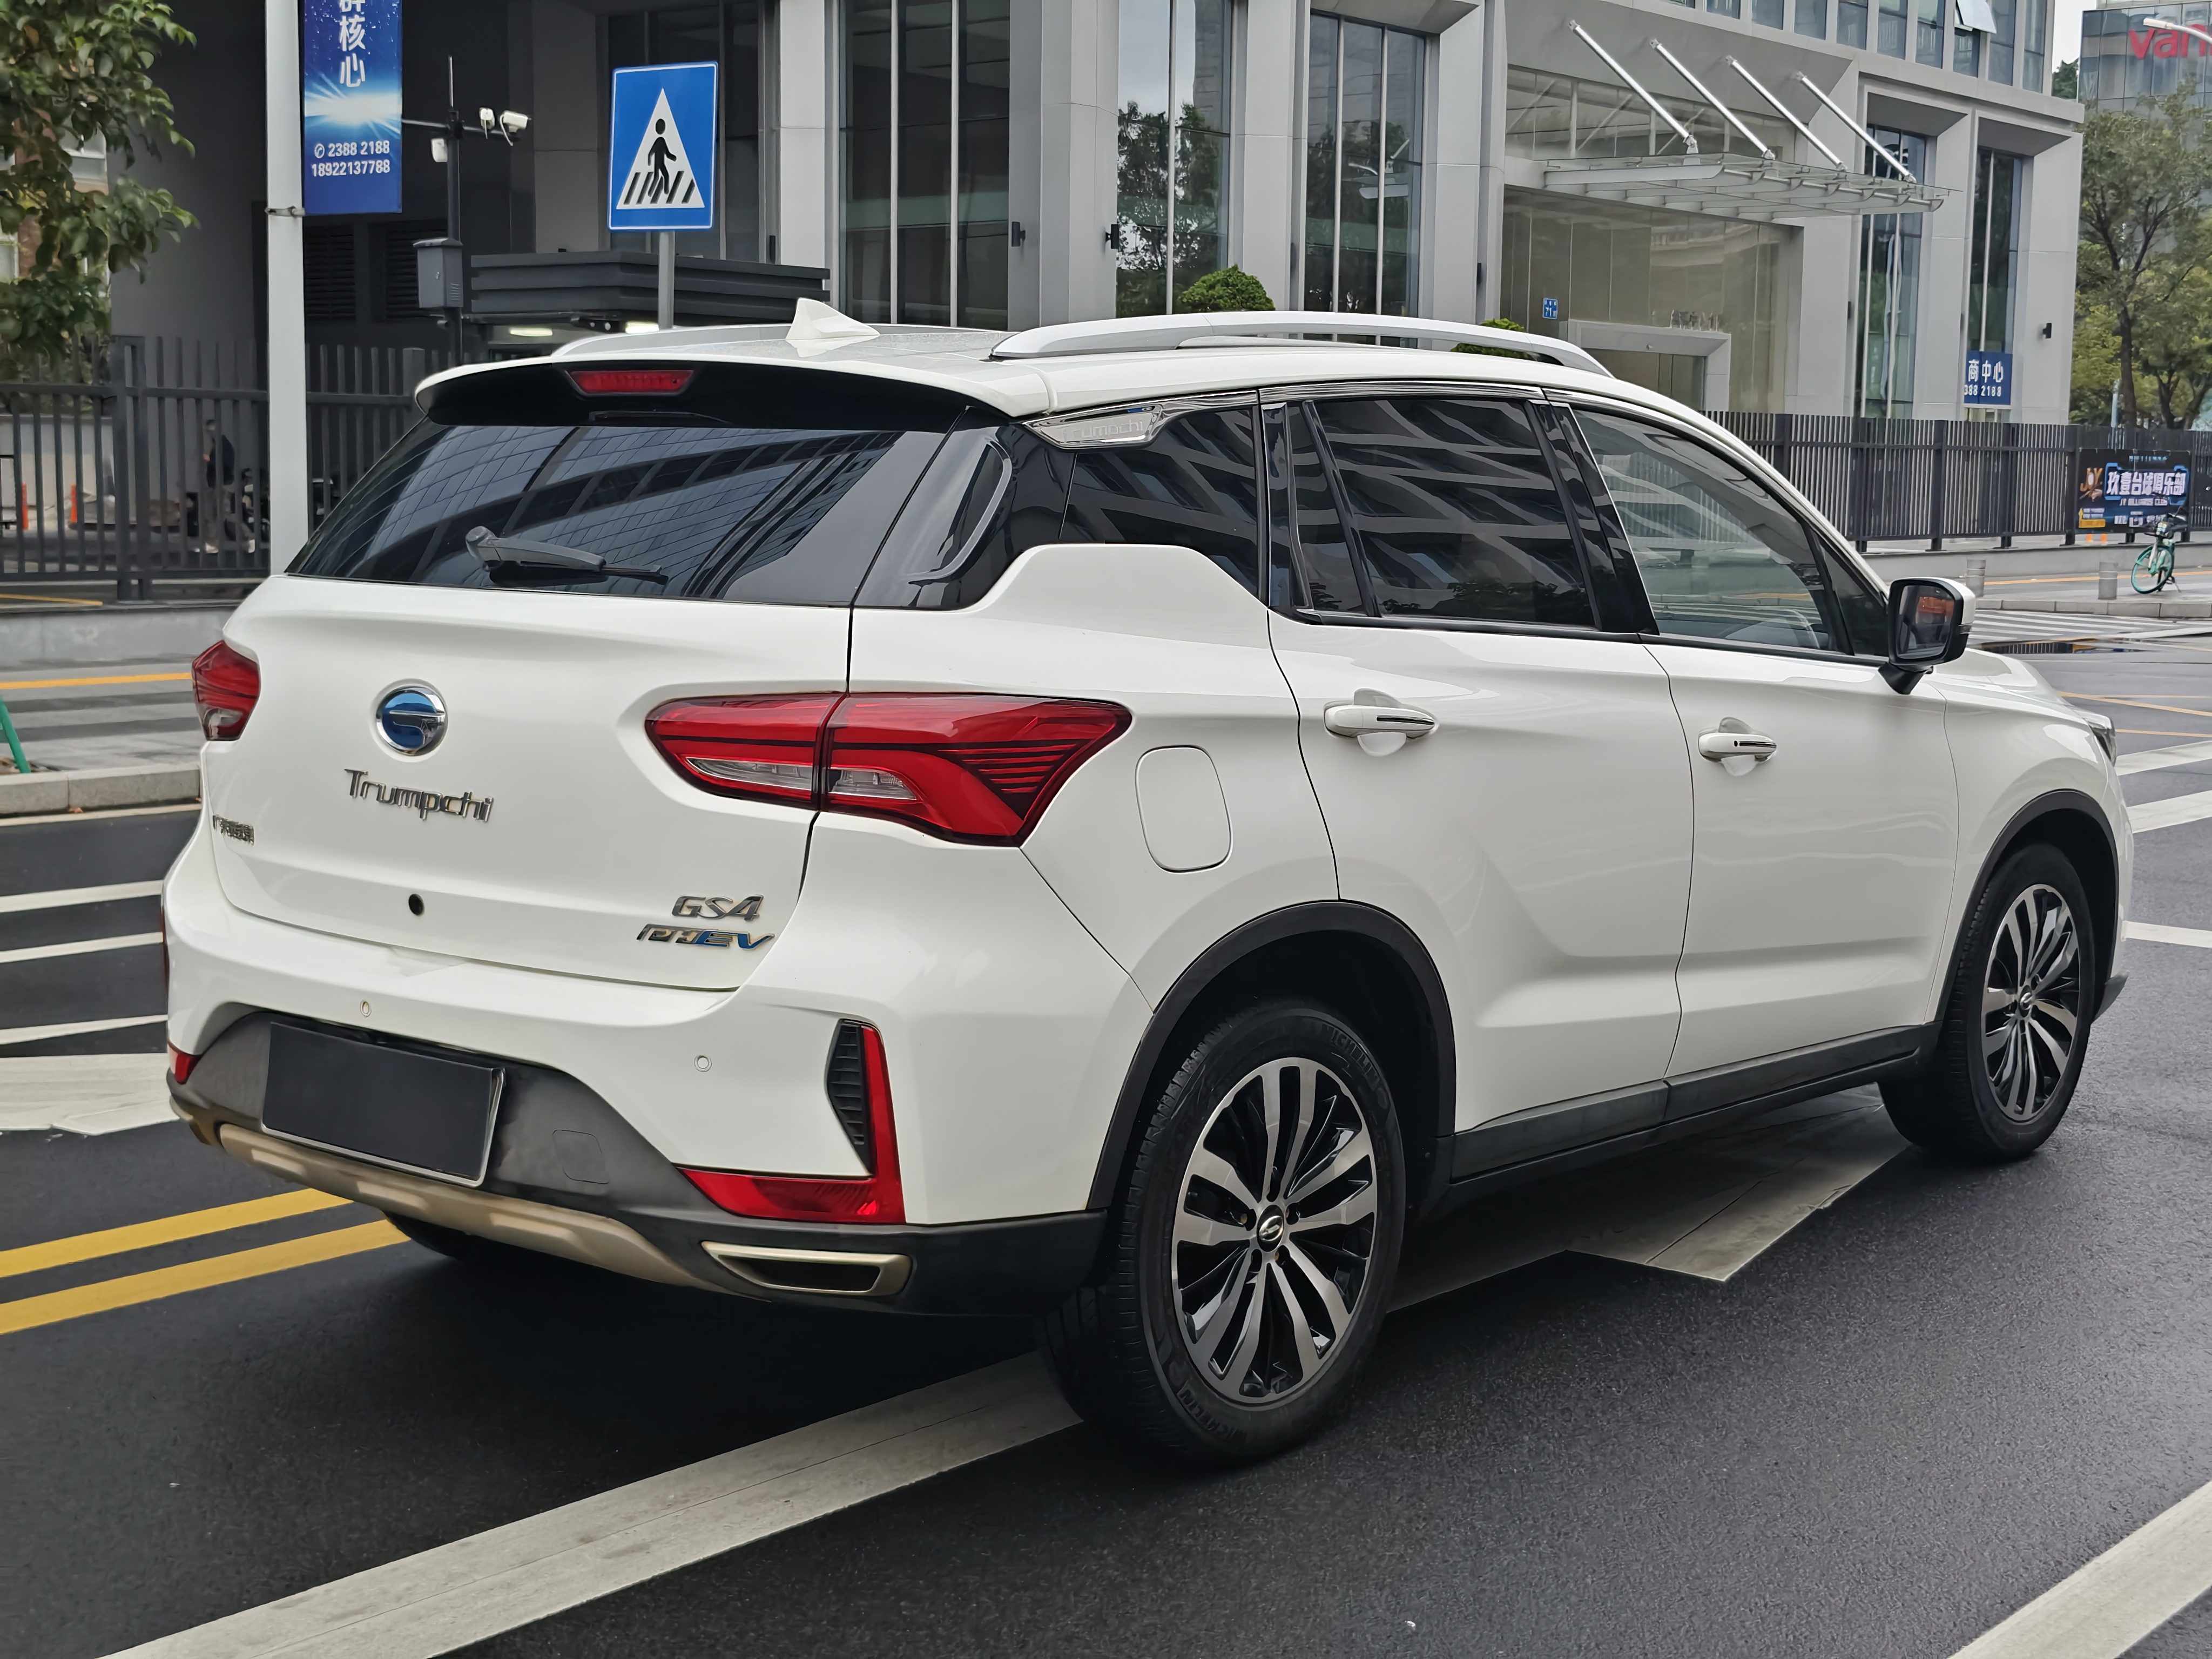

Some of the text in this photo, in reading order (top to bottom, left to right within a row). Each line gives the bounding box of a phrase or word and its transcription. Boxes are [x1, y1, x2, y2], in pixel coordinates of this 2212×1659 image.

[328, 140, 390, 157] 2388 2188
[312, 159, 390, 177] 18922137788
[1981, 385, 2001, 396] 2188
[344, 768, 494, 821] Trumpchi
[672, 895, 765, 921] GS4
[636, 923, 775, 949] PHEV
